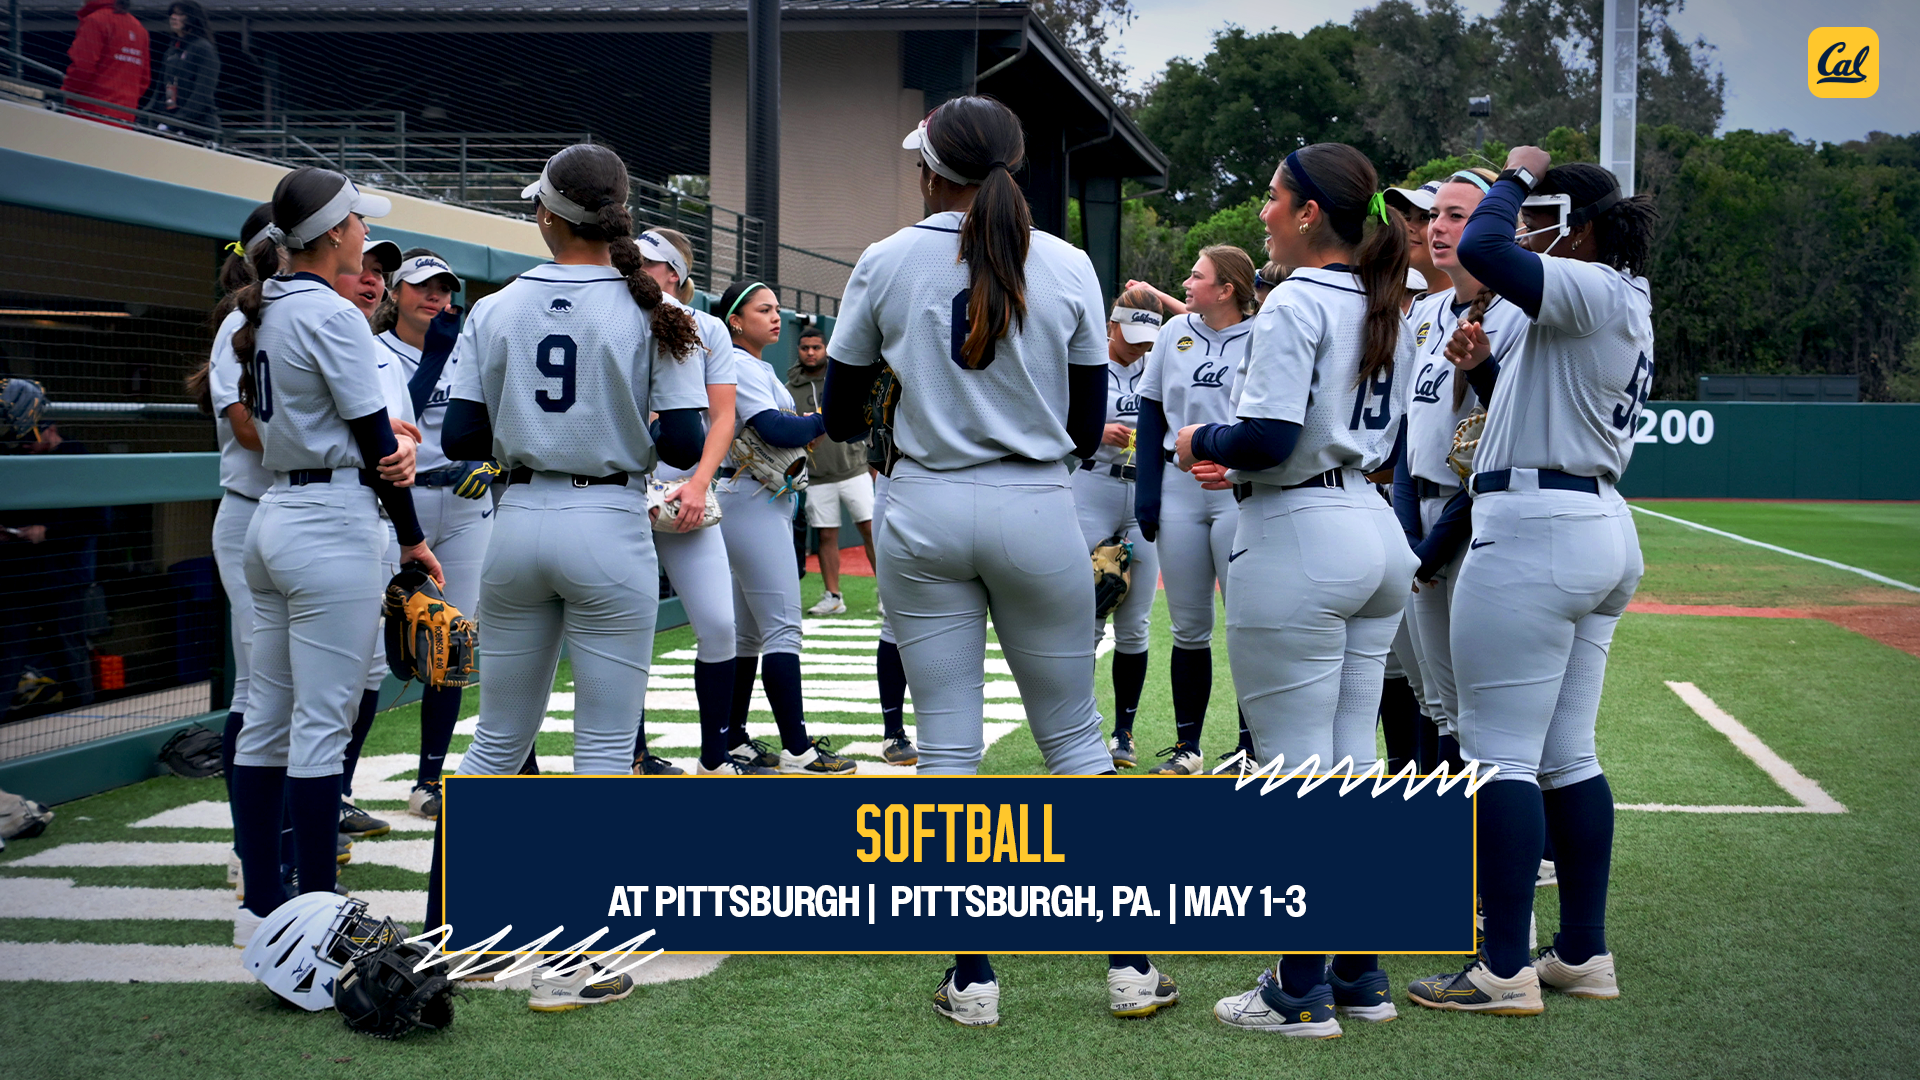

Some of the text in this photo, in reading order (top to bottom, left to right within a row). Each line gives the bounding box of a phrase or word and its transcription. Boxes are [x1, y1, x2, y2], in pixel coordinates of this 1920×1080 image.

[251, 349, 274, 423] 0
[535, 333, 578, 414] 9
[1191, 361, 1229, 388] Cal
[1349, 352, 1395, 430] 19
[1412, 363, 1449, 404] Cal
[1613, 350, 1654, 439] 55
[427, 385, 451, 408] al
[1116, 394, 1141, 418] Cal
[1635, 408, 1715, 445] 200
[434, 626, 444, 670] ROBINSON #00
